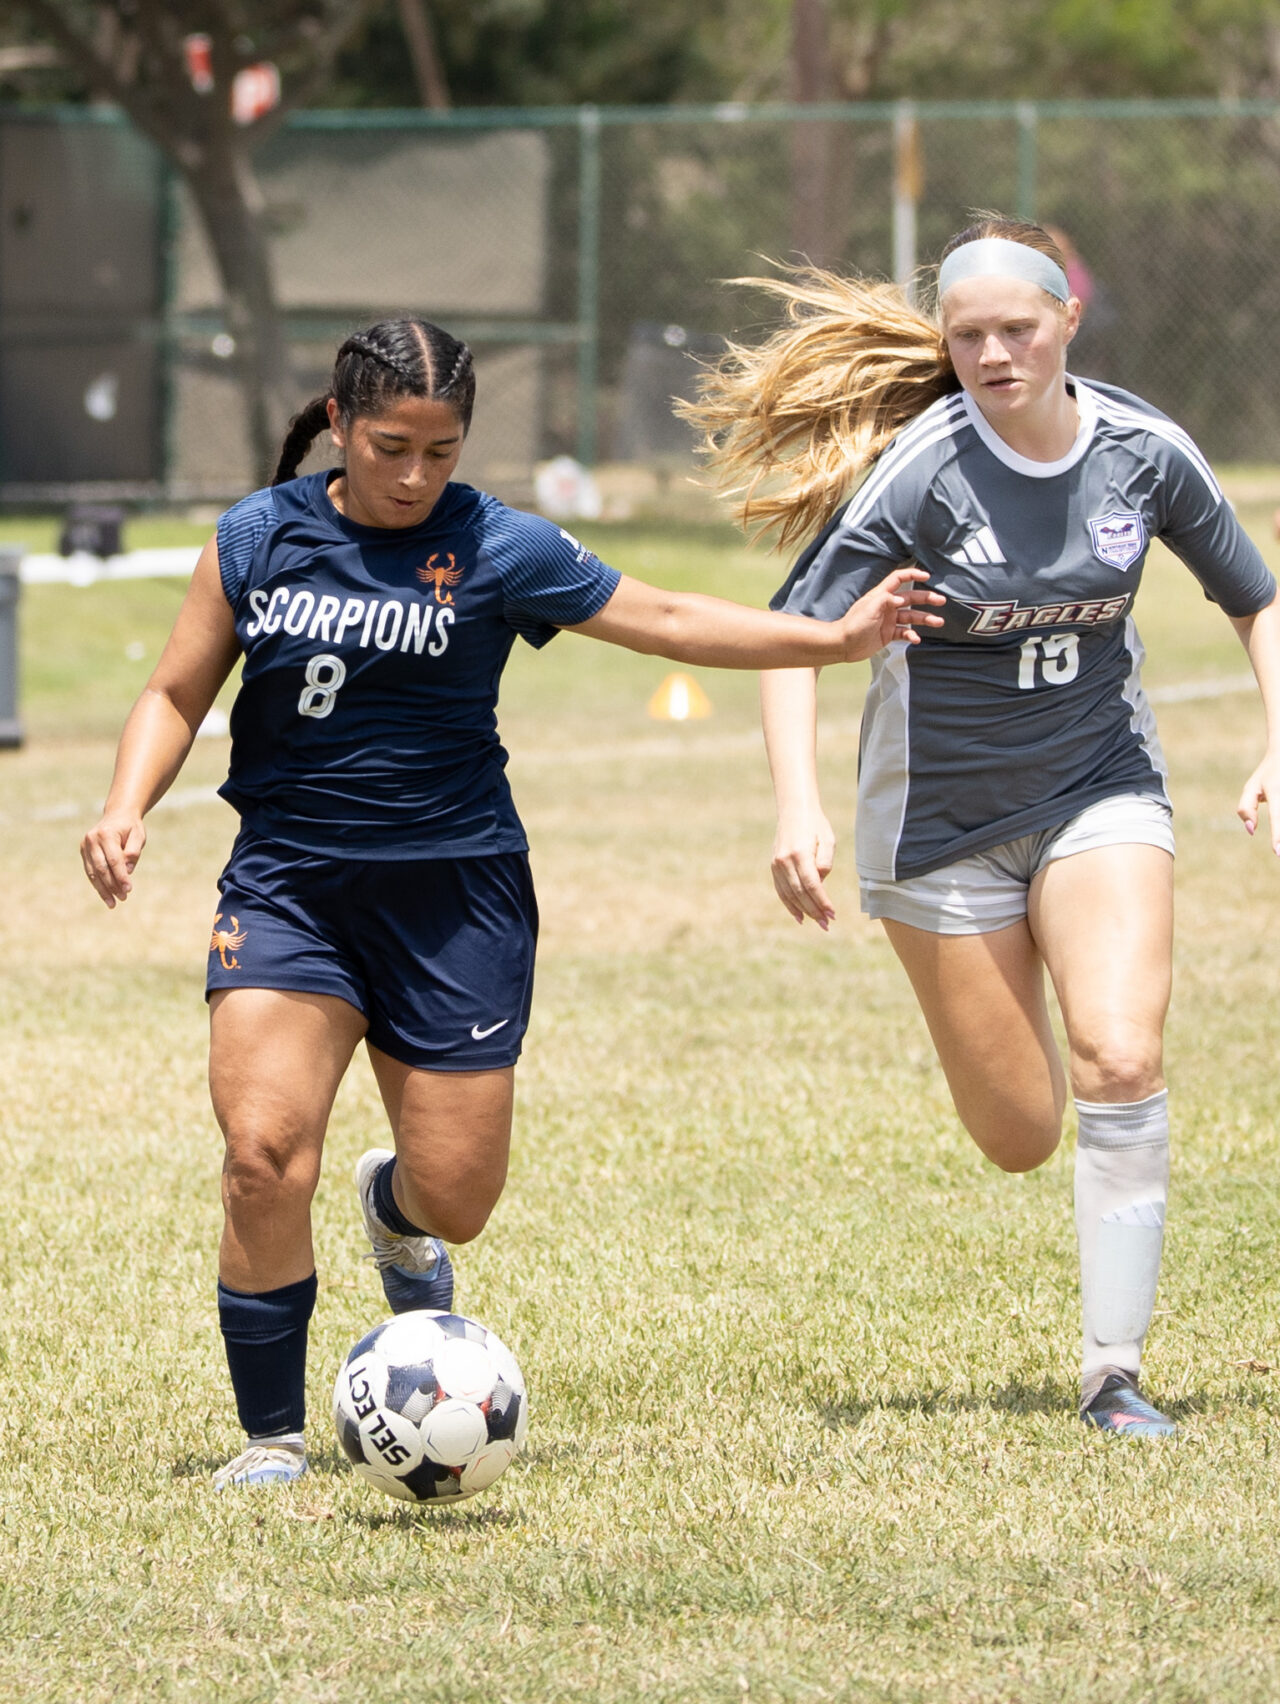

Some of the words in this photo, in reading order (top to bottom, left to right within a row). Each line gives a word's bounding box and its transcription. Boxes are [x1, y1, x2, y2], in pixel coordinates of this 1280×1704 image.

[247, 587, 455, 657] SCORPIONS
[963, 592, 1131, 636] EAGLES
[298, 654, 347, 719] 8
[349, 1367, 411, 1466] SELECT
